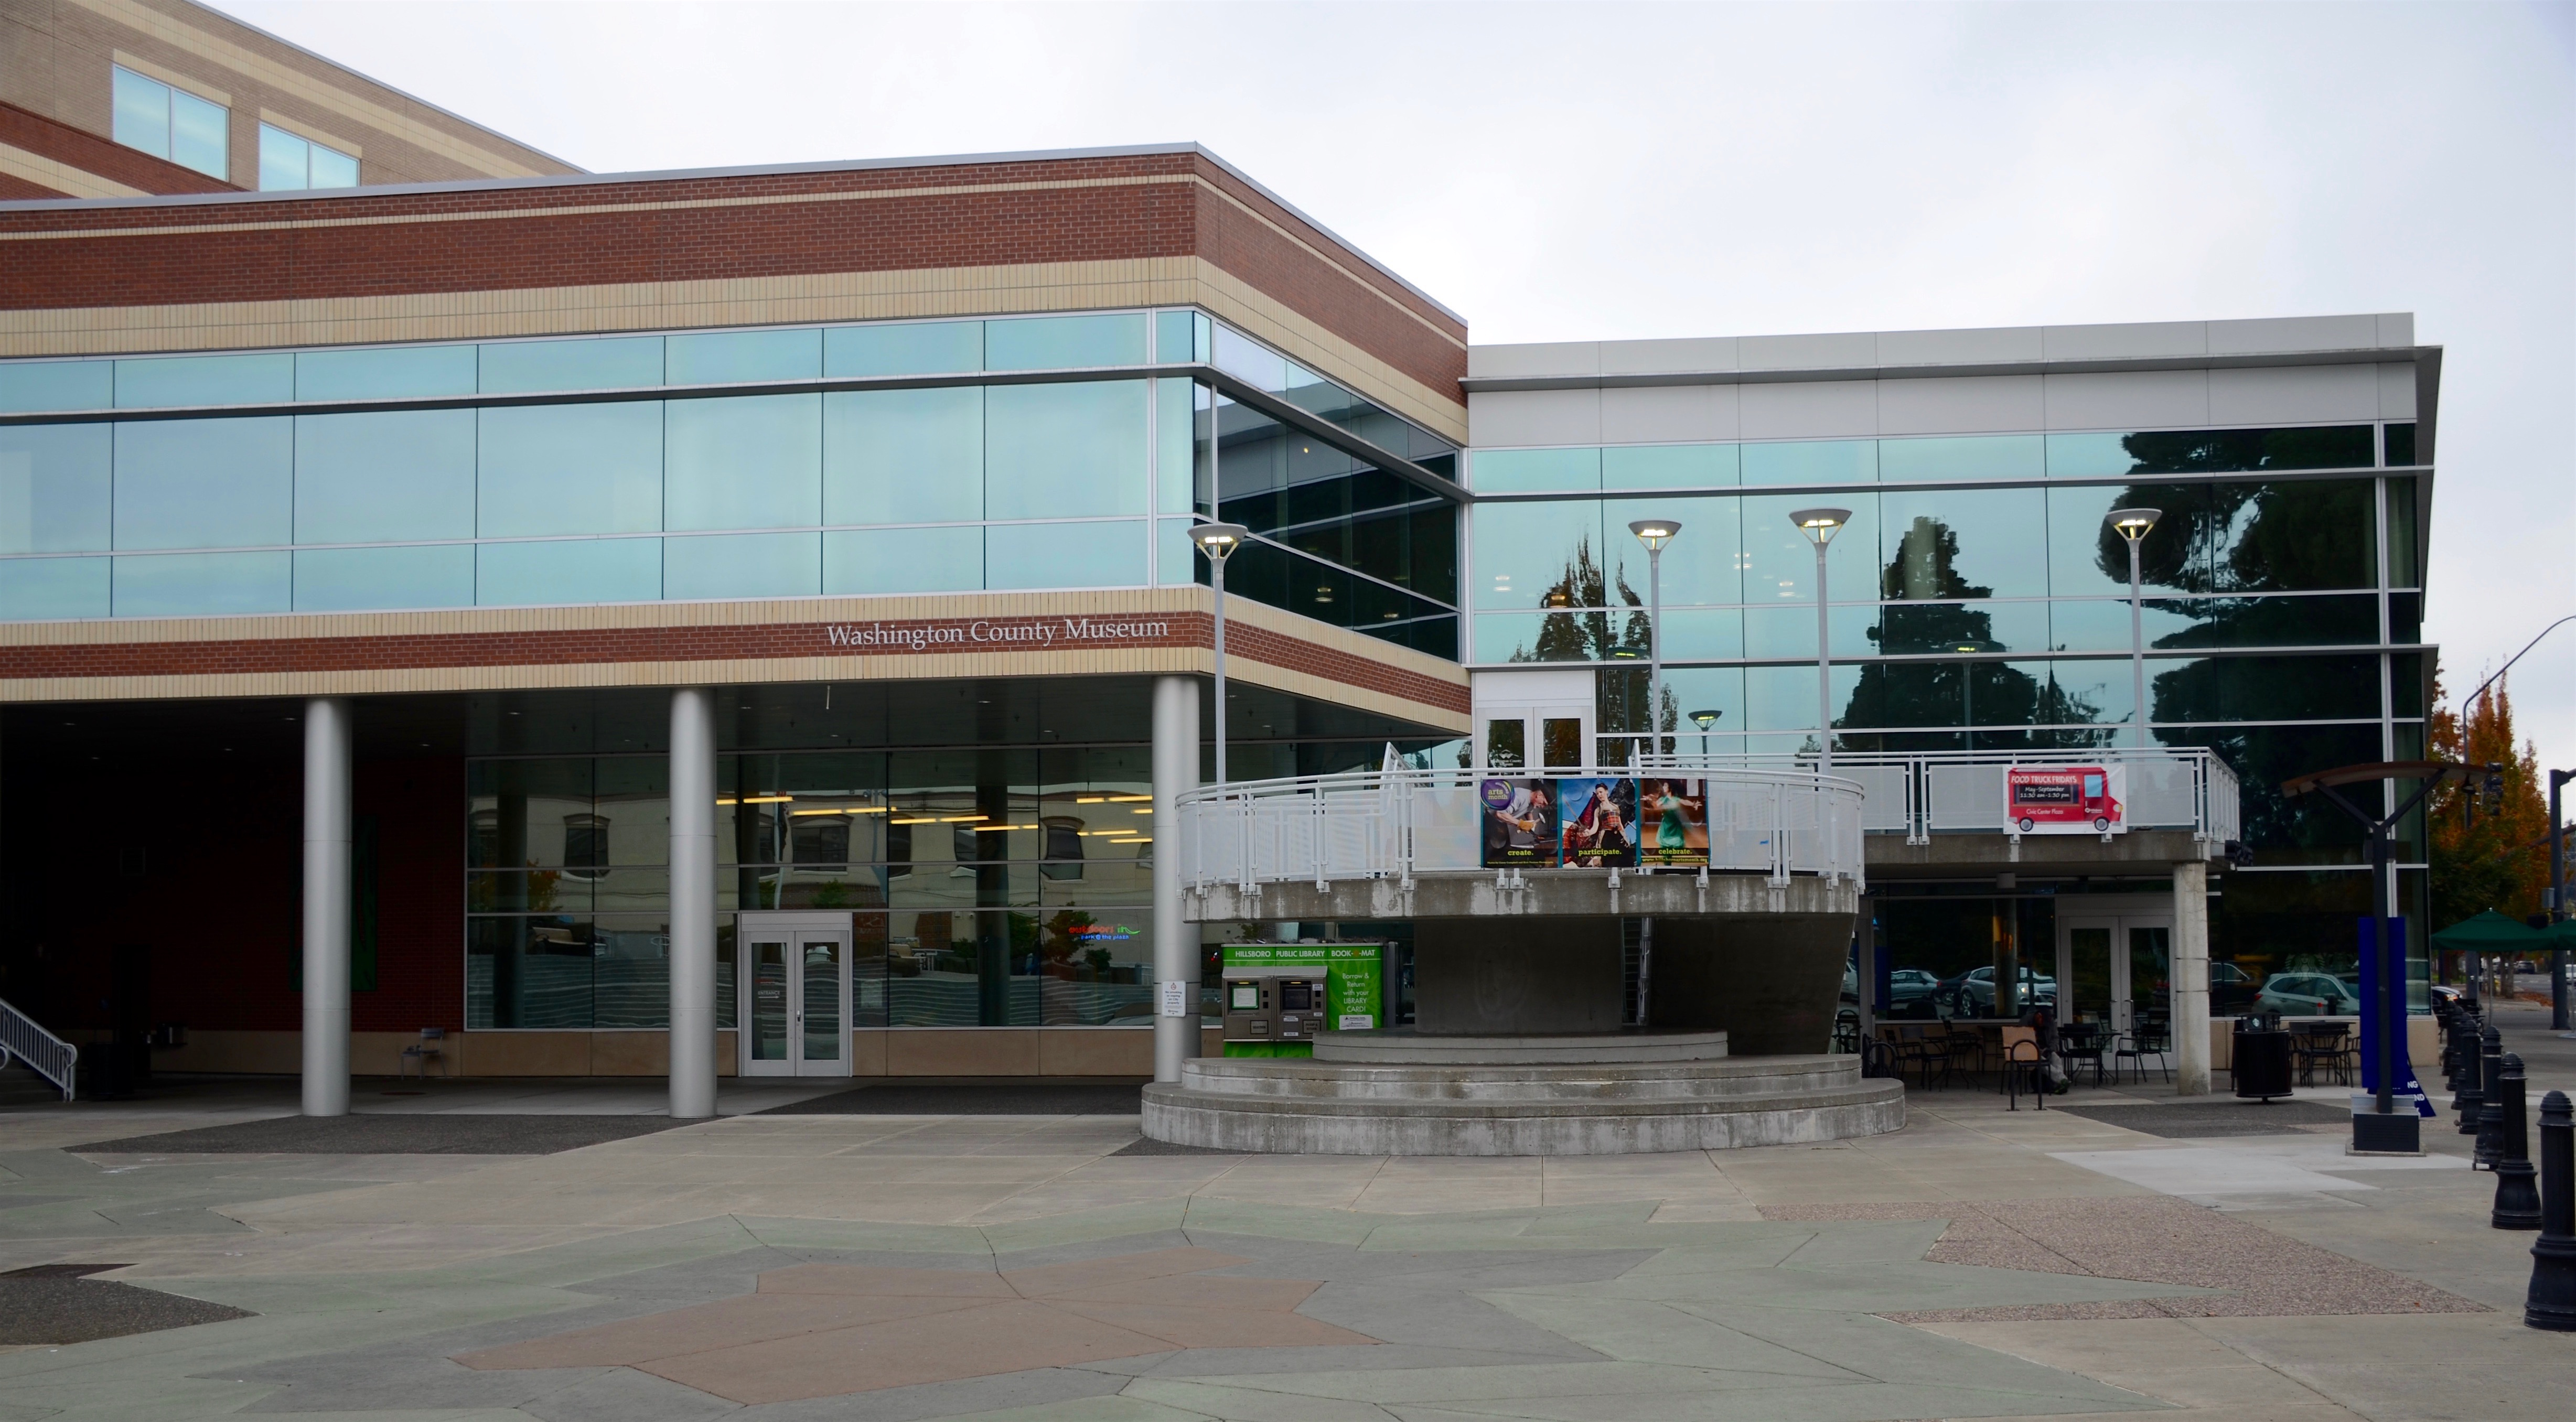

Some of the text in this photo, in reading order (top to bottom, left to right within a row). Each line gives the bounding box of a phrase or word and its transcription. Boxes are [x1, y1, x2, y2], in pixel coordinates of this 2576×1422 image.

[827, 619, 1168, 650] Washington County Museum
[1578, 848, 1622, 857] participate.
